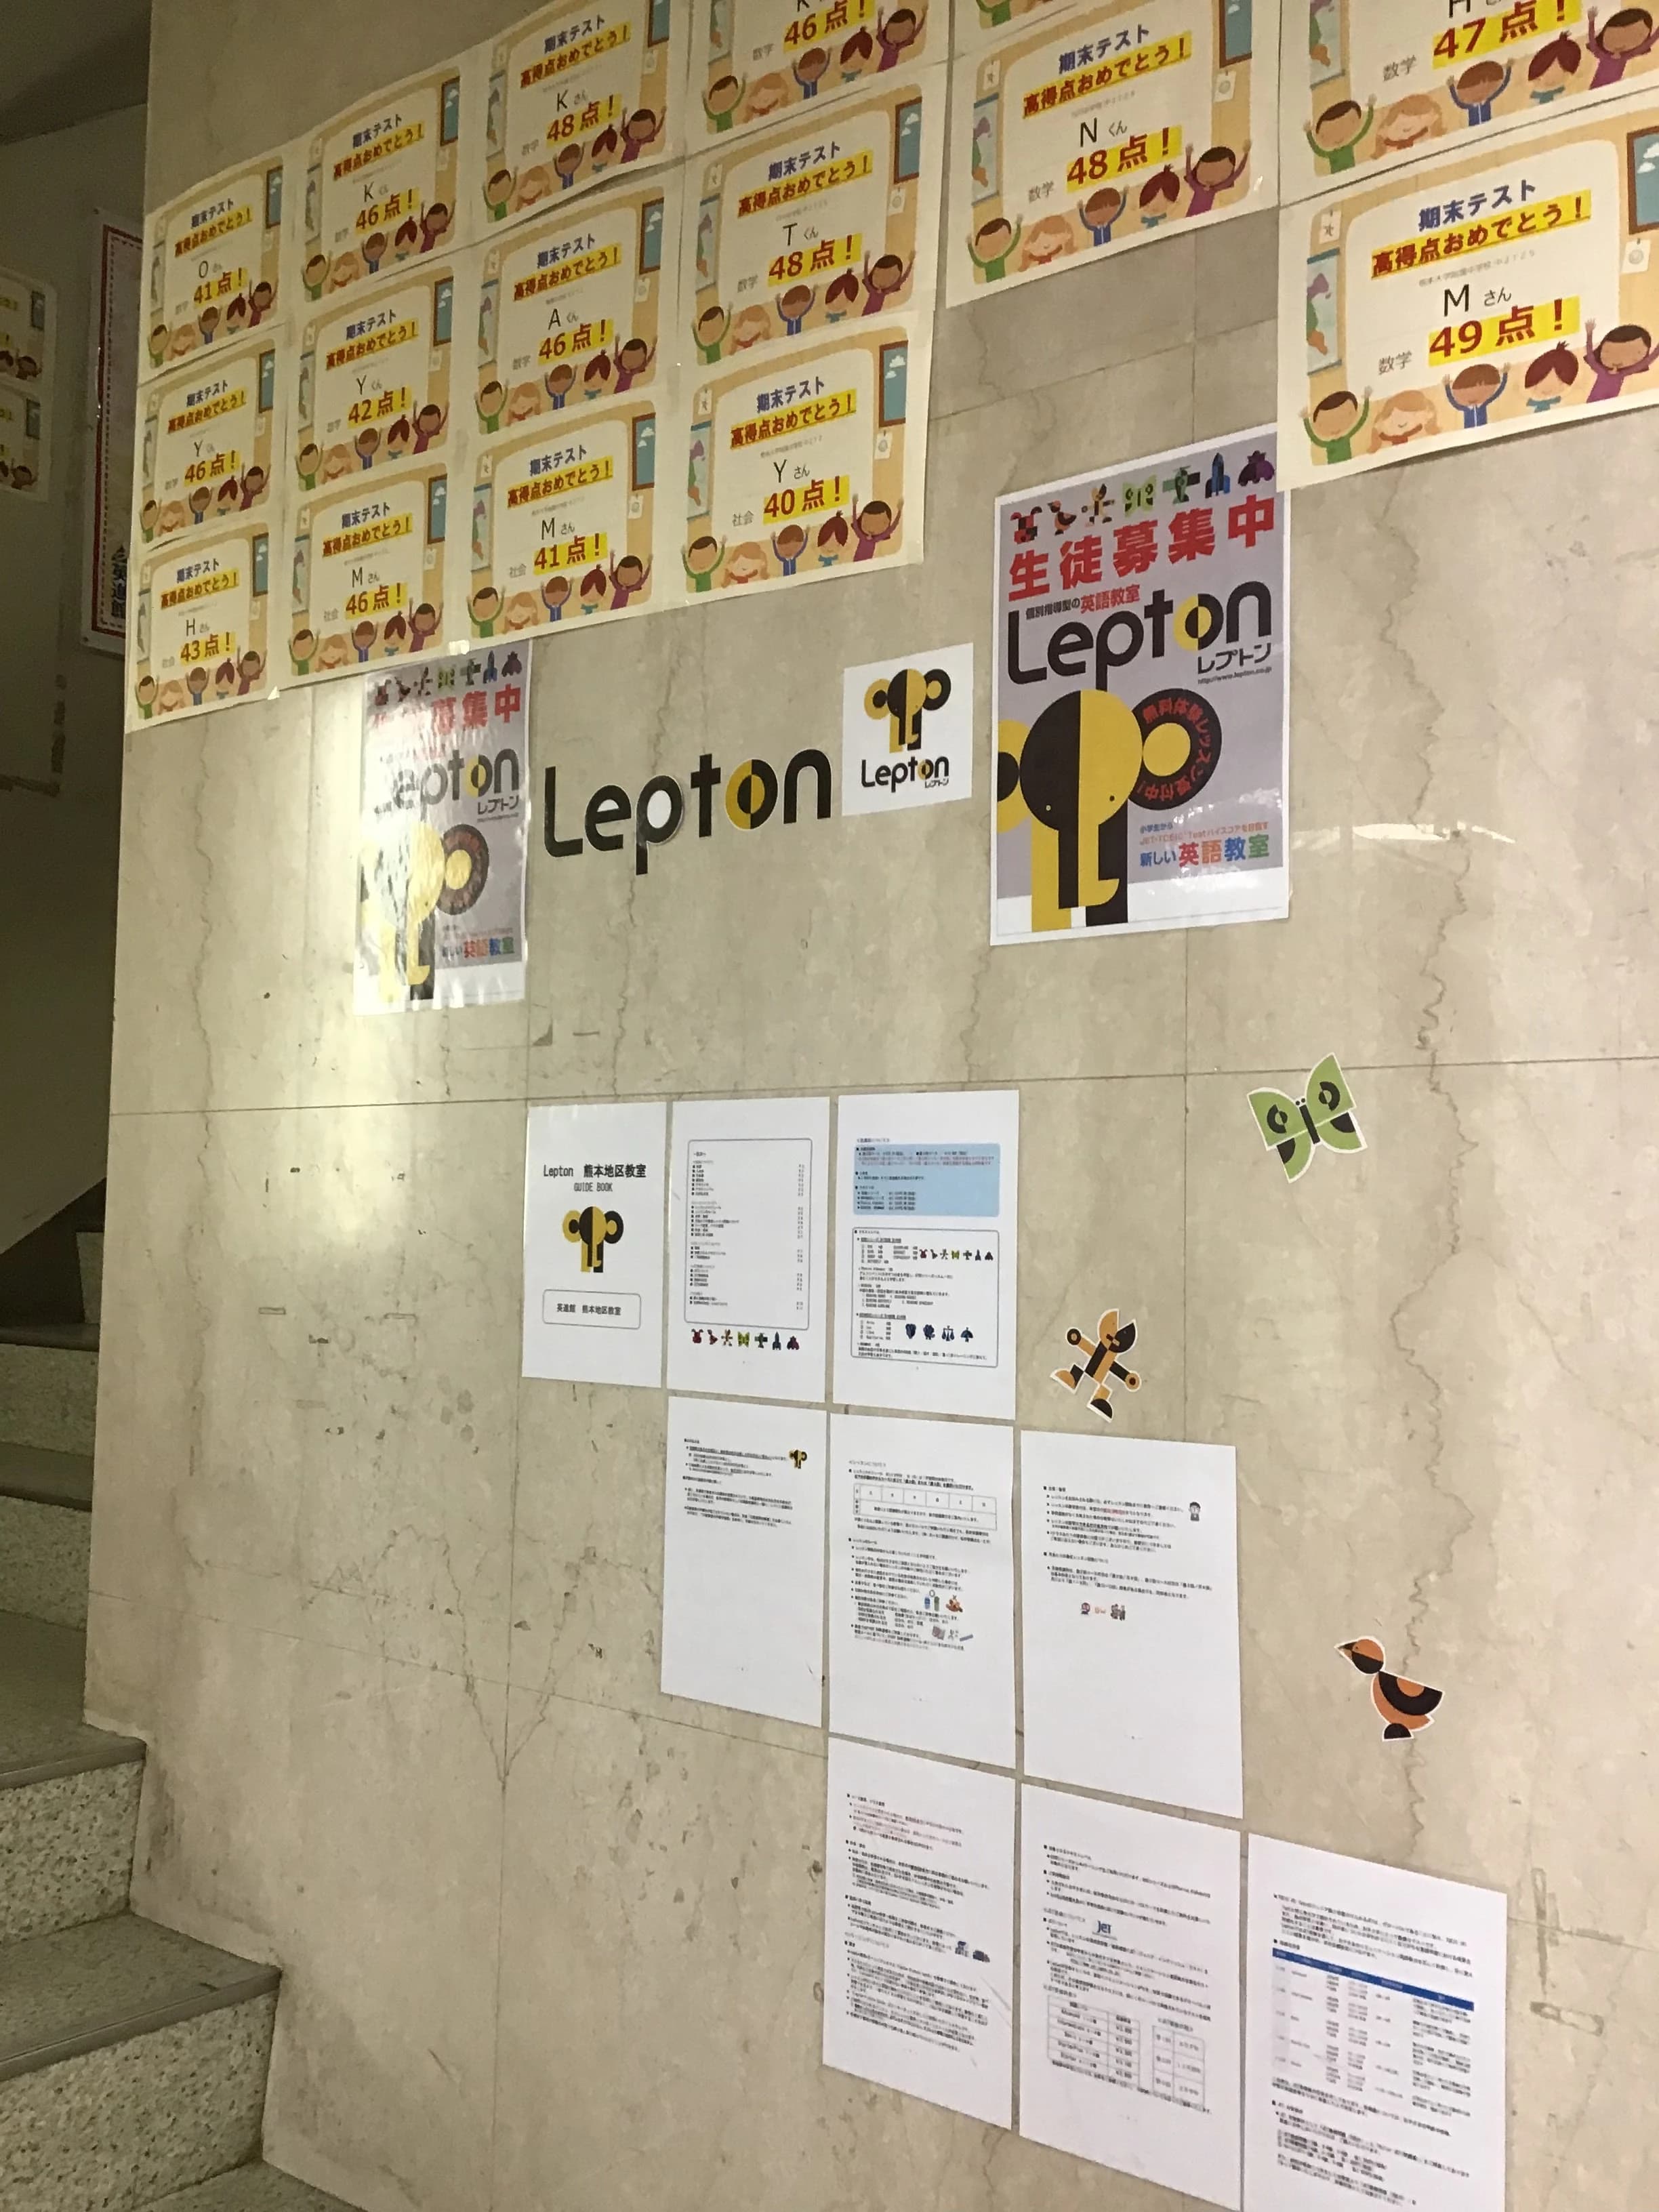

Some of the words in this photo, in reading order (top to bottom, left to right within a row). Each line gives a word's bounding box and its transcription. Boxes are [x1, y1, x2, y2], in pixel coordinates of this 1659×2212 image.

[1059, 24, 1149, 75] 期末テスト
[1383, 54, 1417, 81] 数学
[1023, 37, 1185, 119] 高得点おめでとう！
[556, 89, 569, 112] K
[1080, 117, 1098, 148] N
[1108, 120, 1128, 137] くん
[767, 141, 840, 181] 期末テスト
[1028, 181, 1054, 203] 数学
[1067, 127, 1169, 185] 48点！
[364, 182, 375, 202] K
[737, 155, 868, 218] 高得点おめでとう！
[1418, 180, 1536, 232] 期末テスト
[537, 233, 595, 269] 期末テスト
[783, 222, 798, 246] T
[803, 227, 819, 240] くん
[1371, 195, 1582, 279] 高得点おめでとう！
[513, 247, 617, 301] 高得点おめでとう！
[769, 234, 853, 280] 48点！
[1444, 284, 1469, 317] M
[1484, 287, 1511, 306] さん
[548, 308, 561, 330] A
[566, 311, 579, 324] くん
[1379, 350, 1412, 375] 数学
[1429, 298, 1563, 358] 49点！
[539, 319, 606, 360] 46点！
[356, 375, 367, 395] Y
[757, 376, 824, 413] 期末テスト
[730, 394, 852, 449] 高得点おめでとう！
[194, 441, 203, 457] Y
[529, 445, 587, 476] 期末テスト
[507, 460, 609, 509] 高得点おめでとう！
[773, 459, 787, 483] Y
[794, 464, 810, 480] さん
[342, 501, 391, 529] 期末テスト
[732, 510, 754, 527] 社会
[764, 476, 840, 518] 40点！
[541, 517, 555, 540] M
[560, 522, 575, 535] さん
[534, 533, 599, 570] 41点！
[1008, 494, 1275, 602] 生徒募集中
[352, 567, 363, 588] M
[368, 573, 380, 584] さん
[346, 583, 401, 615] 46点！
[186, 618, 195, 636] H
[1008, 581, 1271, 691] Lepton
[1198, 642, 1271, 674] レプトン
[374, 748, 519, 822] epton
[861, 756, 949, 793] Lepton
[478, 795, 519, 815] レプトン
[544, 748, 832, 875] Lepton
[1140, 834, 1270, 867] 新しい英語教室
[544, 1164, 574, 1179] Lepton
[583, 1163, 647, 1178] 熊本地区教室
[573, 1182, 594, 1192] GUIDE
[596, 1182, 613, 1192] BOOK
